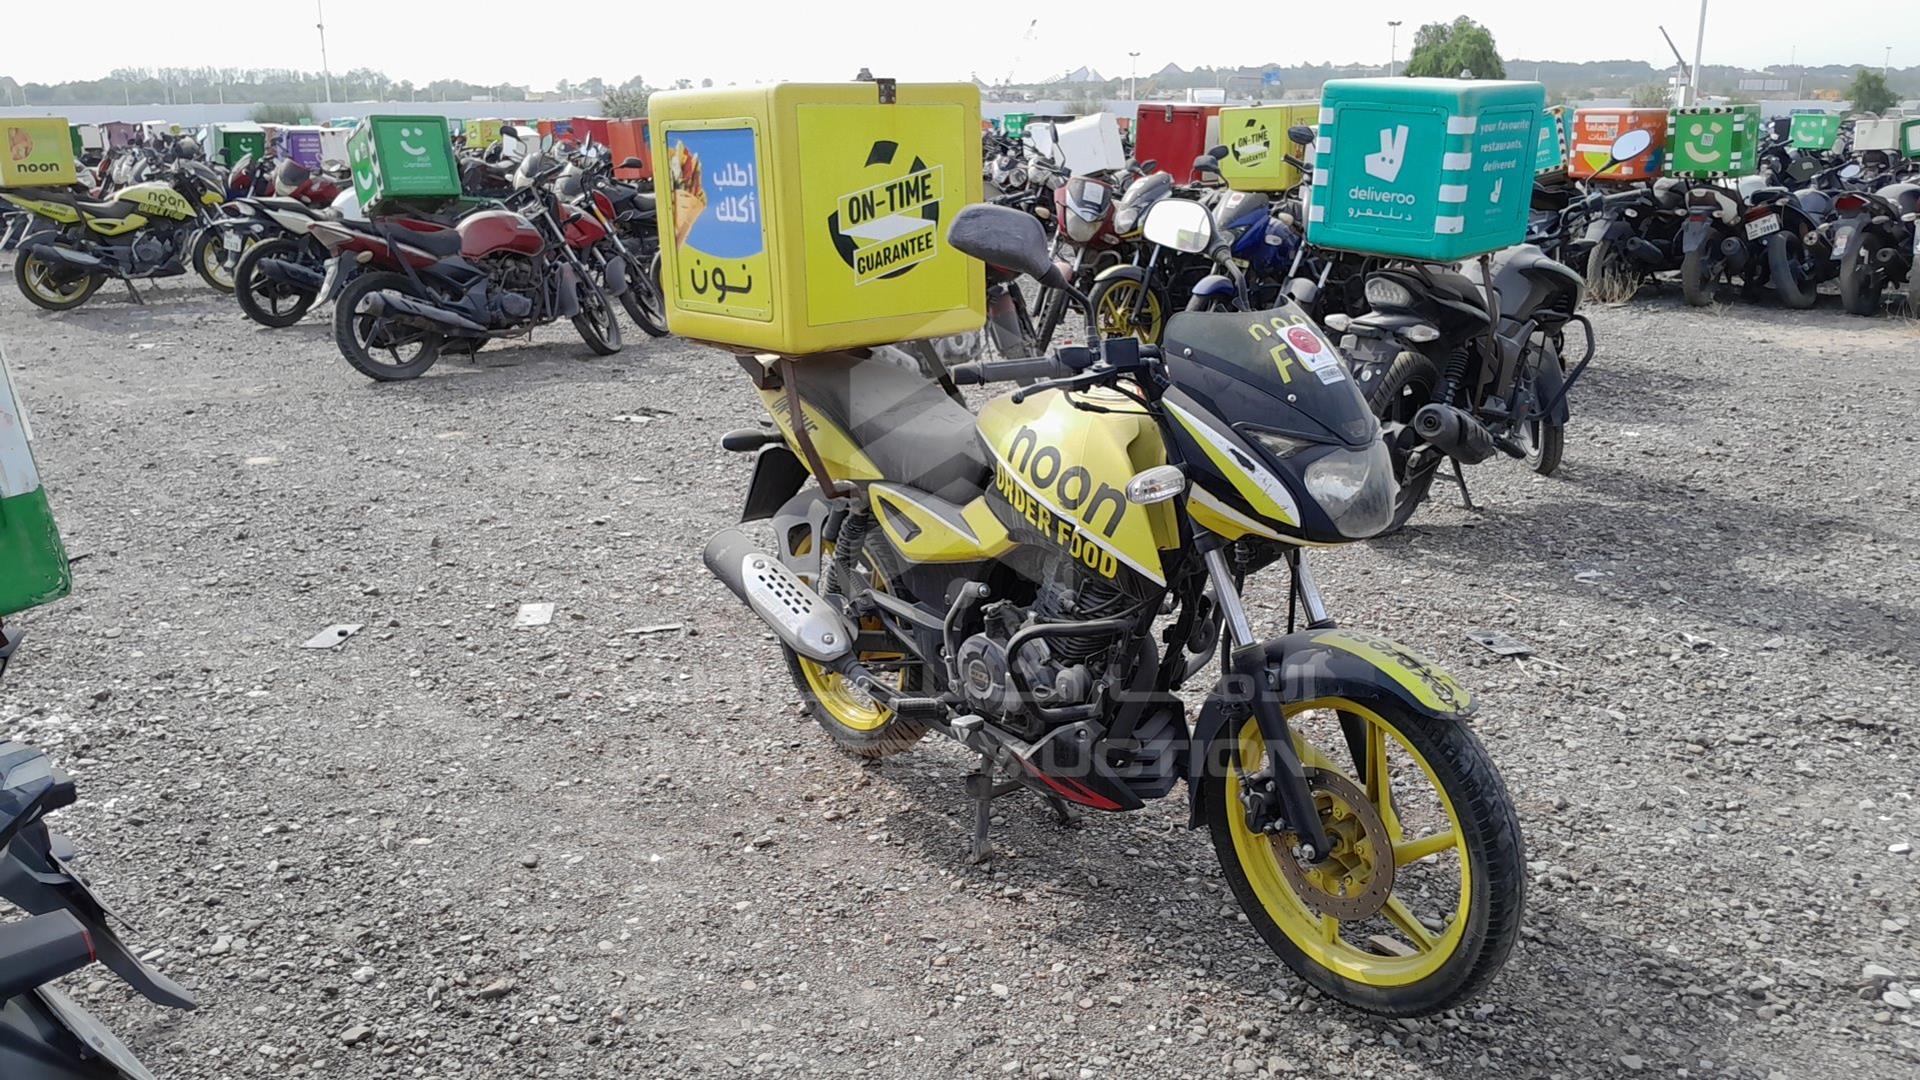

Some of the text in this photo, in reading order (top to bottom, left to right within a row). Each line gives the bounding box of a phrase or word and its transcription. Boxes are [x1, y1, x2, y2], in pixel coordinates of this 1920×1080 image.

[17, 162, 60, 173] noon
[713, 162, 754, 191] اطلب
[1483, 158, 1516, 172] delivered
[147, 191, 186, 208] noon
[715, 192, 756, 223] أكلك
[848, 173, 934, 225] ON-TIME
[1348, 185, 1416, 206] deliveroo
[856, 232, 934, 275] GUARANTEE
[690, 258, 752, 304] نون
[1007, 425, 1127, 539] noon
[995, 460, 1119, 579] ORDER FOOD
